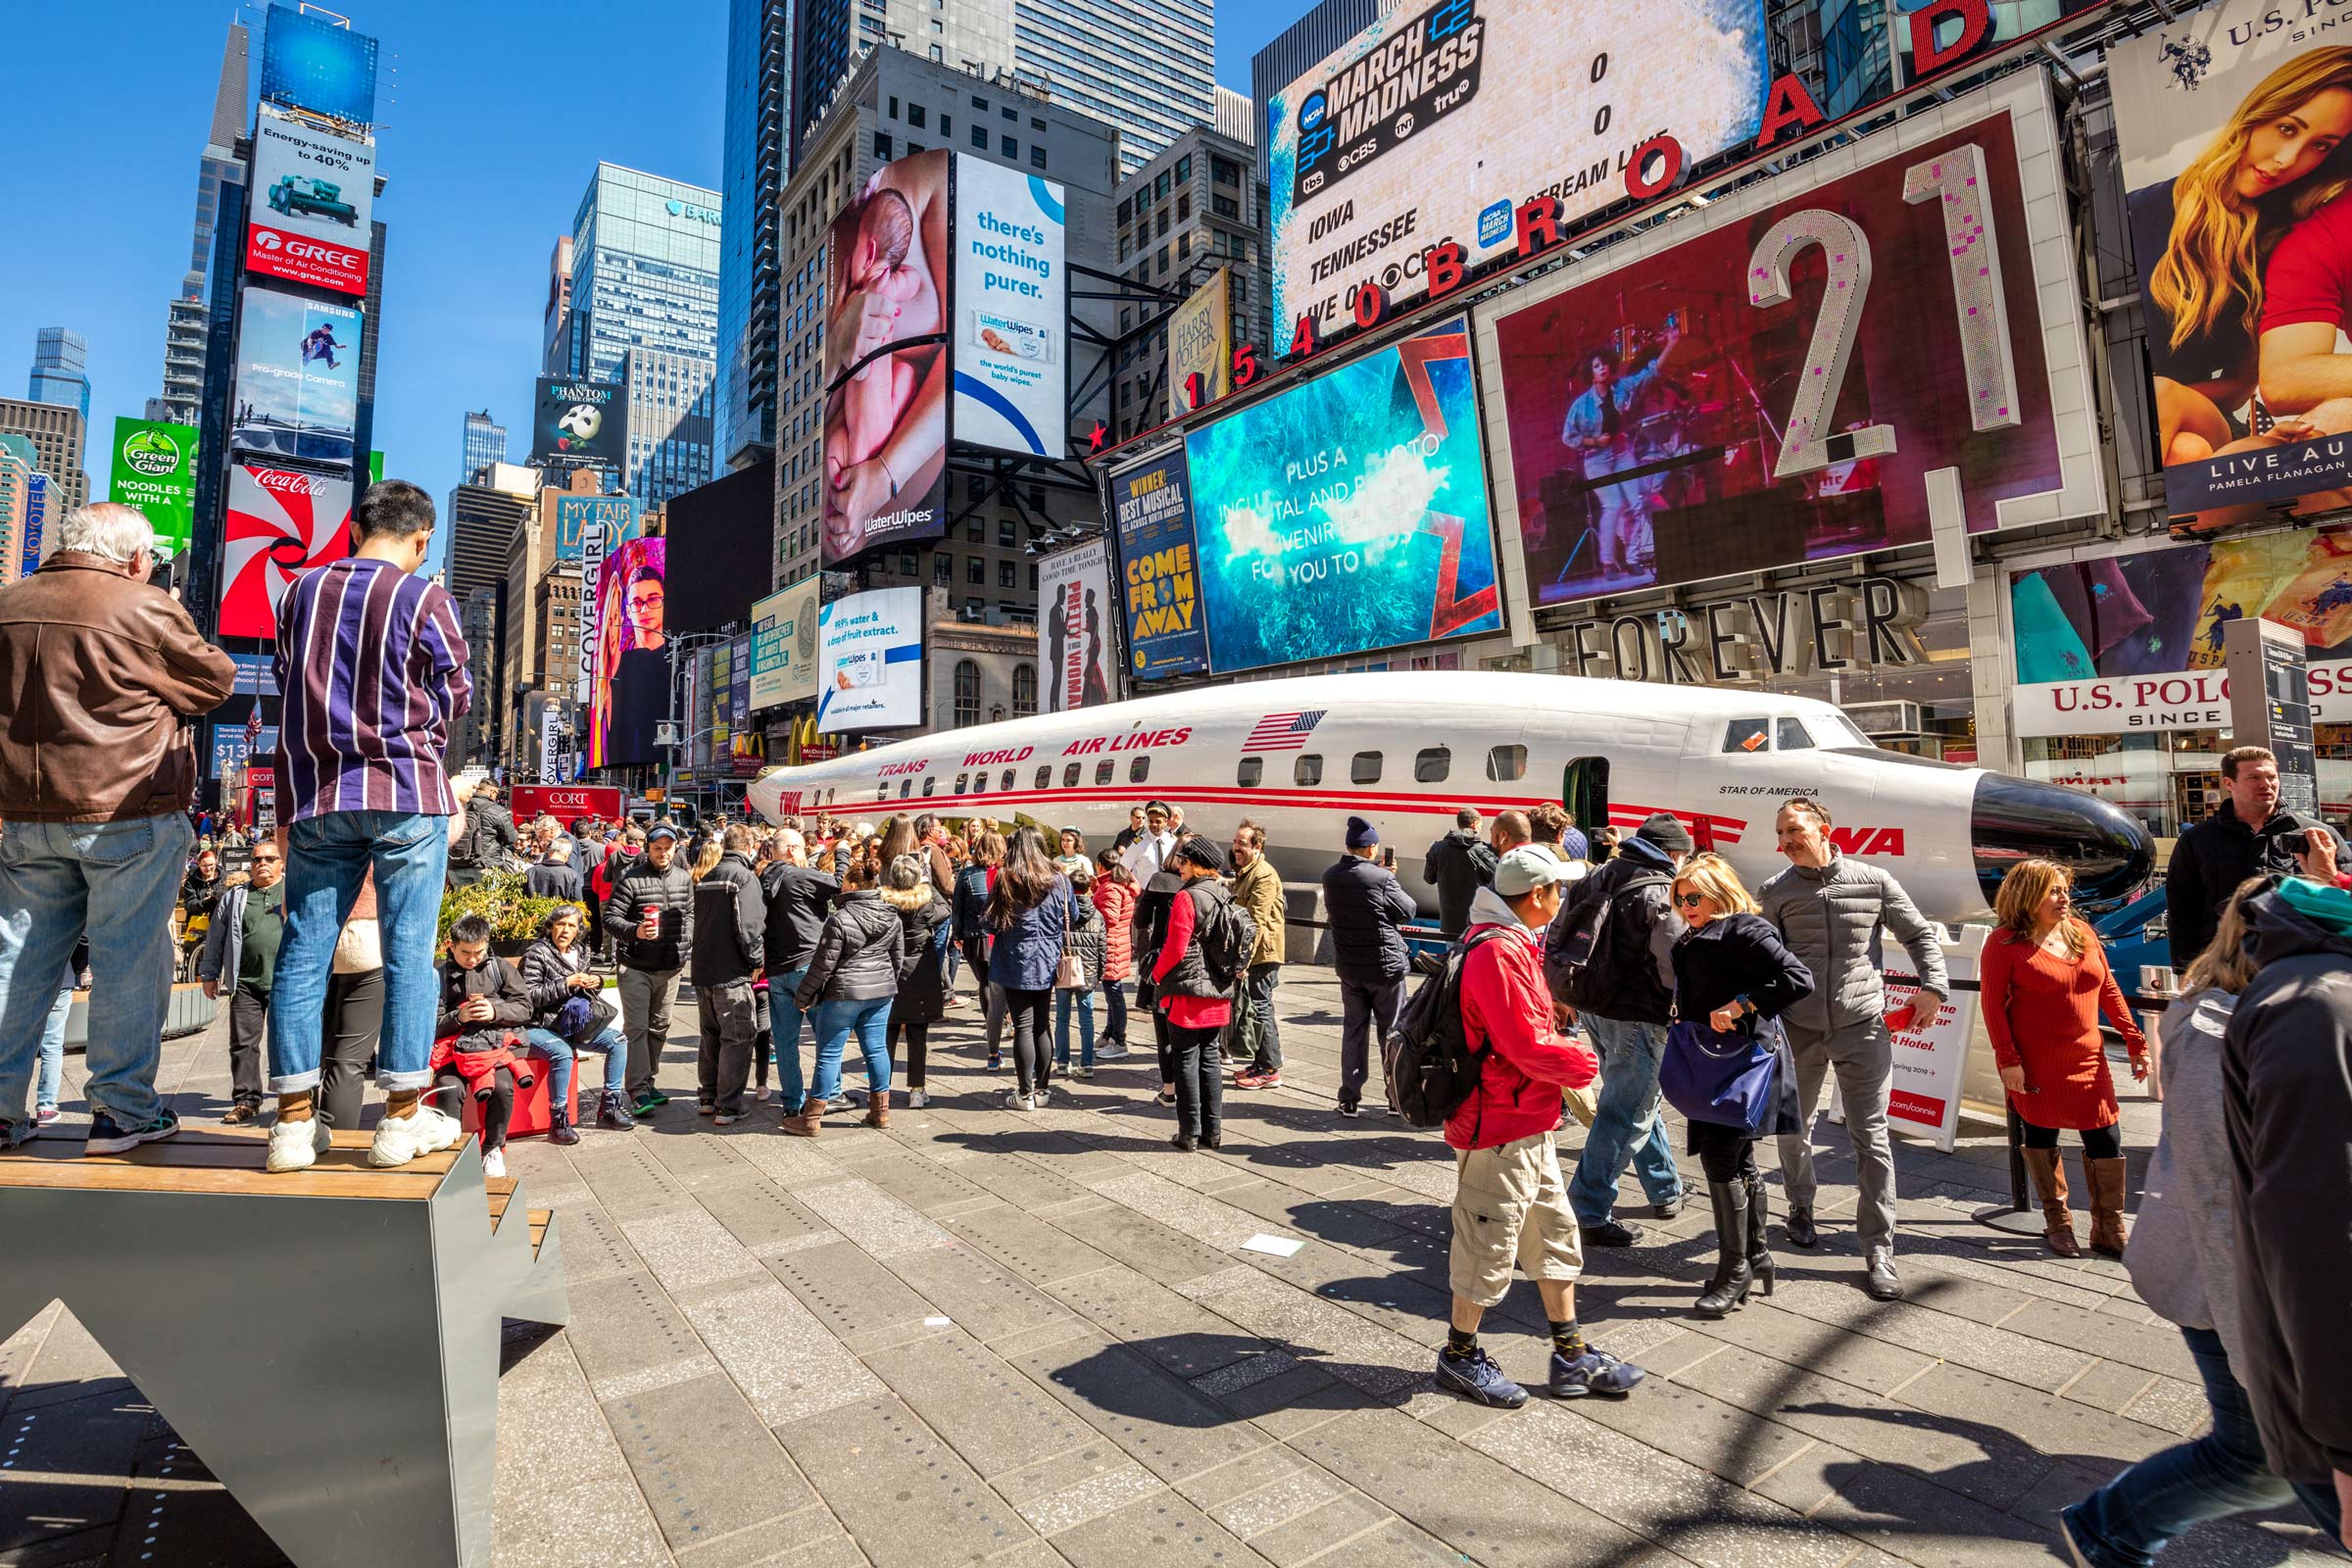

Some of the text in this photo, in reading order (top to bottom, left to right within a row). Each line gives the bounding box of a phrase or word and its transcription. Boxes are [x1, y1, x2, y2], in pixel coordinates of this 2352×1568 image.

[2227, 10, 2293, 46] U.S.
[1327, 19, 1424, 120] MARCH
[1339, 23, 1479, 148] MADNESS
[1303, 105, 1324, 125] NCAA
[1396, 117, 1414, 135] TNT
[264, 128, 371, 165] Energy-saving up
[1350, 138, 1377, 164] CBS
[298, 150, 349, 171] to 40%
[1304, 173, 1322, 191] tbs
[977, 211, 1044, 245] there's
[1308, 199, 1354, 245] IOWA
[1482, 213, 1509, 231] MARCH
[286, 241, 360, 269] GREE
[1311, 207, 1417, 285] TENNESSEE
[253, 249, 283, 263] Master
[296, 260, 308, 268] Air
[310, 263, 362, 283] Conditioning
[972, 241, 1050, 278] nothing
[272, 265, 344, 286] www.gree.com
[985, 272, 1042, 299] purer.
[307, 302, 355, 319] SAMSUNG
[980, 314, 1033, 335] WaterWipes
[1177, 300, 1213, 349] HARRY
[1176, 325, 1216, 372] POTTER
[252, 363, 345, 387] Pro-grade Camera
[980, 359, 1041, 379] the world's purest
[991, 371, 1032, 386] baby wipes.
[551, 386, 612, 400] PHANTOM
[130, 448, 176, 464] Green
[135, 460, 176, 475] Giant
[1286, 446, 1348, 484] PLUS A
[2210, 454, 2279, 478] LIVE
[117, 480, 181, 495] NOODLES
[1129, 470, 1167, 499] WINNER!
[2209, 461, 2345, 491] PAMELA FLANAGAN
[125, 492, 171, 505] WITH A
[1120, 483, 1183, 523] BEST MUSICAL
[1309, 483, 1348, 512] AND
[24, 485, 45, 561] NOVOTEL
[564, 502, 630, 520] MY FAIR
[865, 508, 932, 535] WaterWipes
[1121, 522, 1130, 533] ALL
[1042, 556, 1107, 582] GOOD TIME TONIGHT
[1051, 558, 1067, 570] HAVE
[1074, 548, 1098, 563] REALLY
[1127, 543, 1191, 585] COME
[1289, 551, 1359, 584] YOU TO
[581, 527, 603, 673] COVERGIRL
[1068, 580, 1081, 639] PRETTY
[850, 615, 870, 626] water
[871, 611, 879, 622] &
[1133, 599, 1195, 640] AWAY
[1573, 577, 1914, 684] FOREVER
[831, 636, 841, 646] drop
[842, 633, 847, 642] of
[847, 629, 861, 640] fruit
[863, 625, 898, 637] extract.
[2051, 684, 2123, 712] U.S.
[2128, 710, 2221, 726] SINCE
[876, 727, 1193, 778] TRANS WORLD AIR LINES
[549, 792, 589, 804] CORT
[779, 791, 803, 816] TWA
[1719, 786, 1819, 796] STAR OF AMERICA
[1899, 1038, 1935, 1052] Hotel.
[1892, 1061, 1928, 1075] Spring 2019
